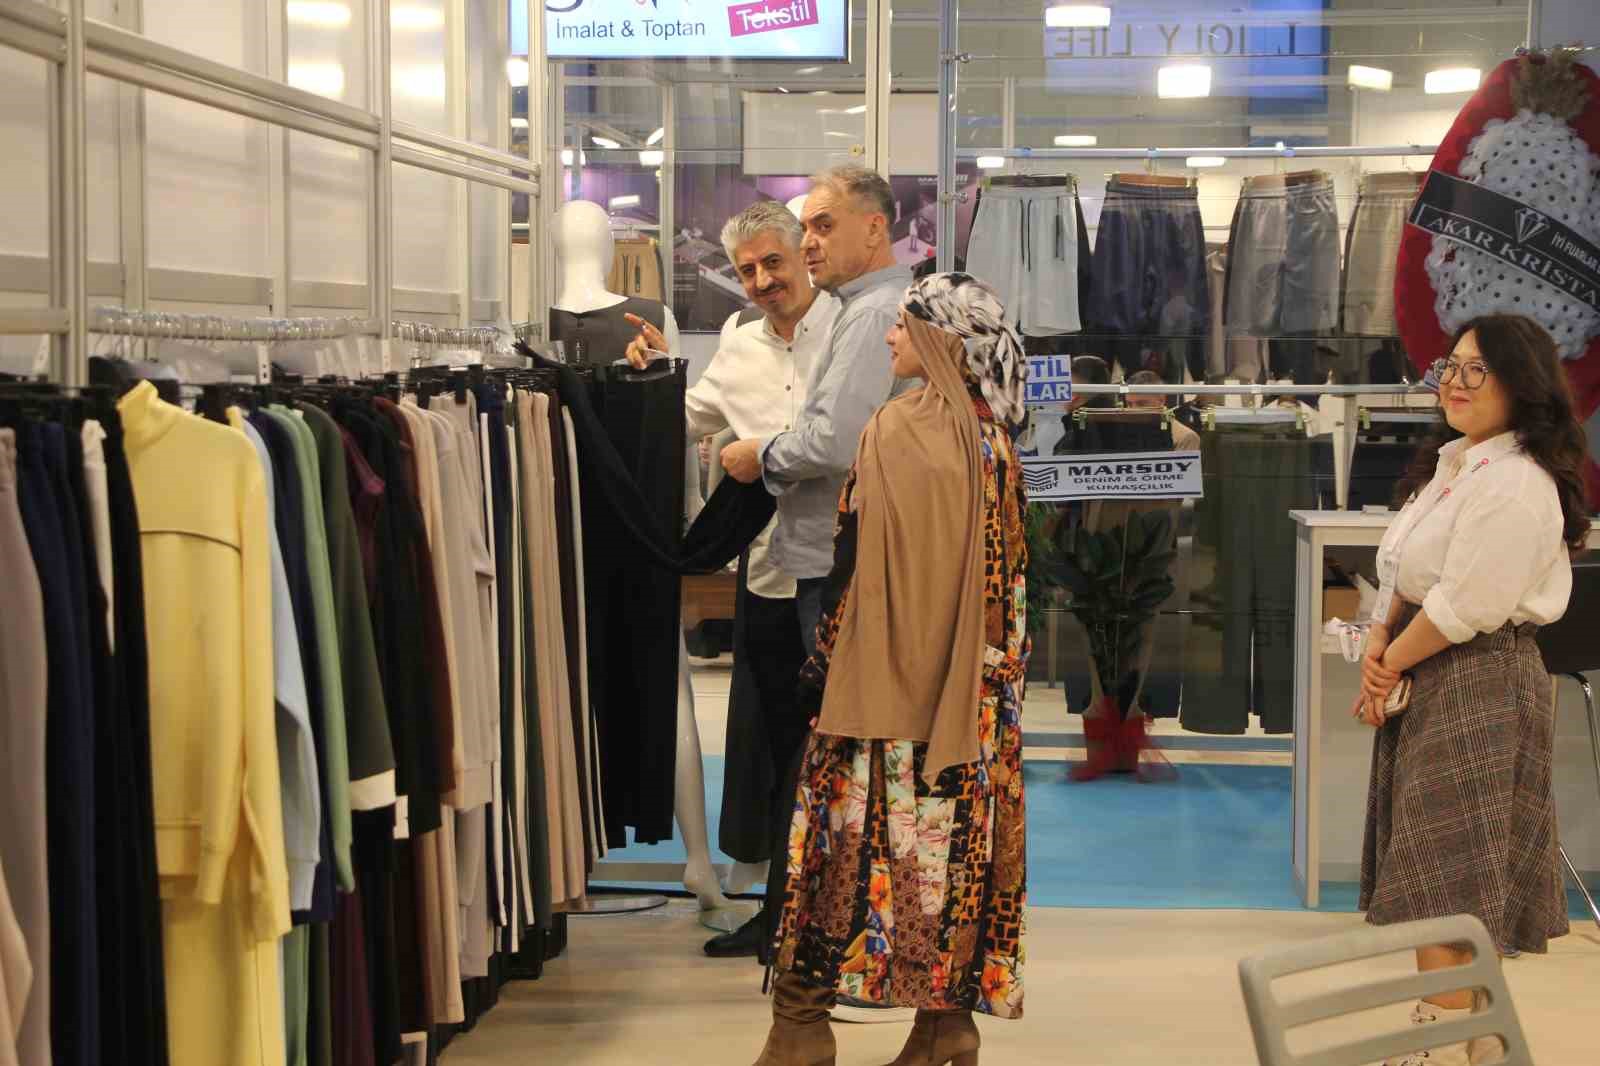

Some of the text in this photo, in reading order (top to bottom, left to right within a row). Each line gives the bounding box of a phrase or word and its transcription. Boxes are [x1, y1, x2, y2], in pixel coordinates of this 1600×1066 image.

[736, 3, 811, 31] Tekstil
[555, 18, 706, 41] İmalat & Toptan
[1428, 216, 1600, 306] AKAR KRİSTA
[1030, 356, 1070, 378] TİL
[1026, 383, 1071, 400] LAR
[1068, 461, 1193, 477] MARSOY
[1126, 475, 1138, 483] &
